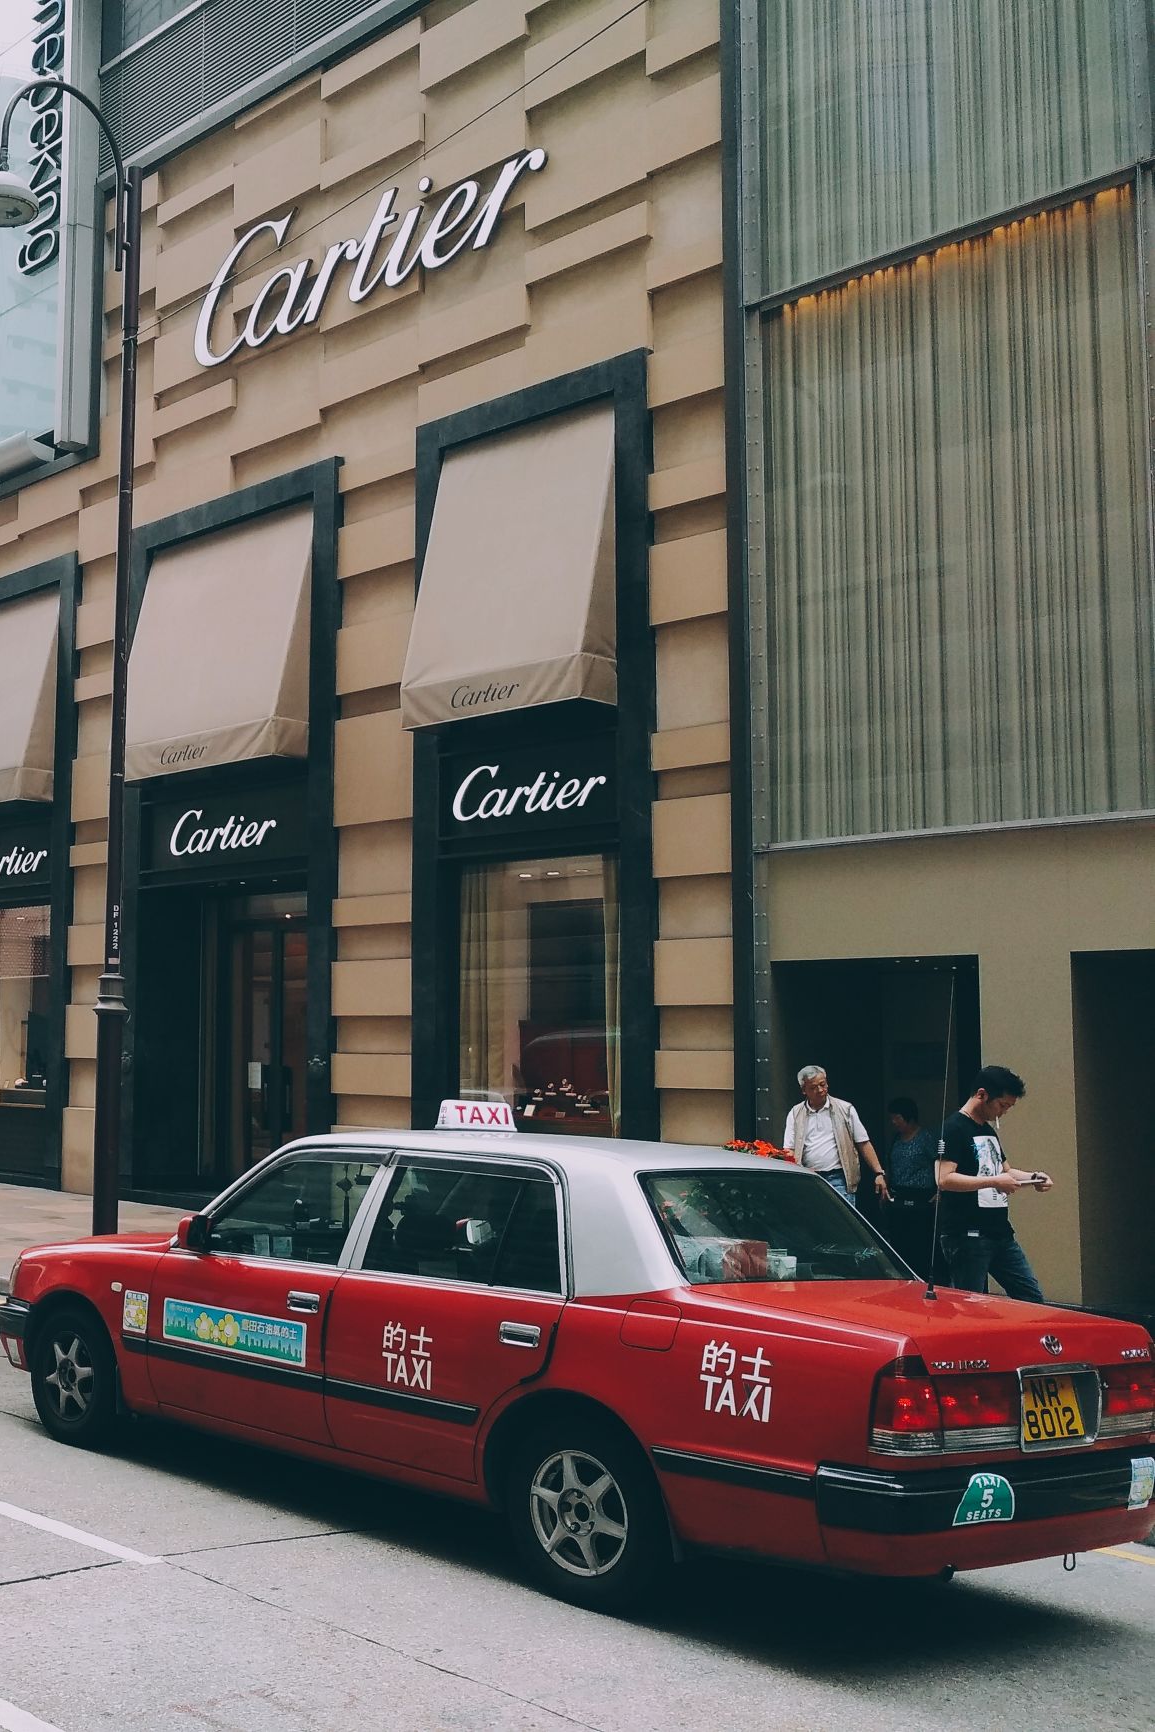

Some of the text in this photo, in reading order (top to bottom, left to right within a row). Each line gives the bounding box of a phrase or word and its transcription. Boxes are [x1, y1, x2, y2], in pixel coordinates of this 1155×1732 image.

[17, 0, 63, 273] nepeking
[194, 147, 548, 368] Cartier
[451, 681, 520, 709] Cartier
[160, 744, 208, 766] Cartier
[452, 765, 607, 822] Cartier
[169, 809, 277, 856] Cartier
[112, 904, 120, 918] DF
[454, 1104, 510, 1125] TAXI
[382, 1320, 433, 1358] 的士
[381, 1351, 432, 1391] TAXI
[701, 1339, 774, 1384] 的士
[699, 1373, 773, 1423] TAXI
[1030, 1378, 1062, 1408] NR
[1025, 1406, 1079, 1439] 8012
[974, 1476, 1001, 1489] TAXI
[981, 1488, 994, 1508] 5
[965, 1508, 1002, 1522] SEATS
